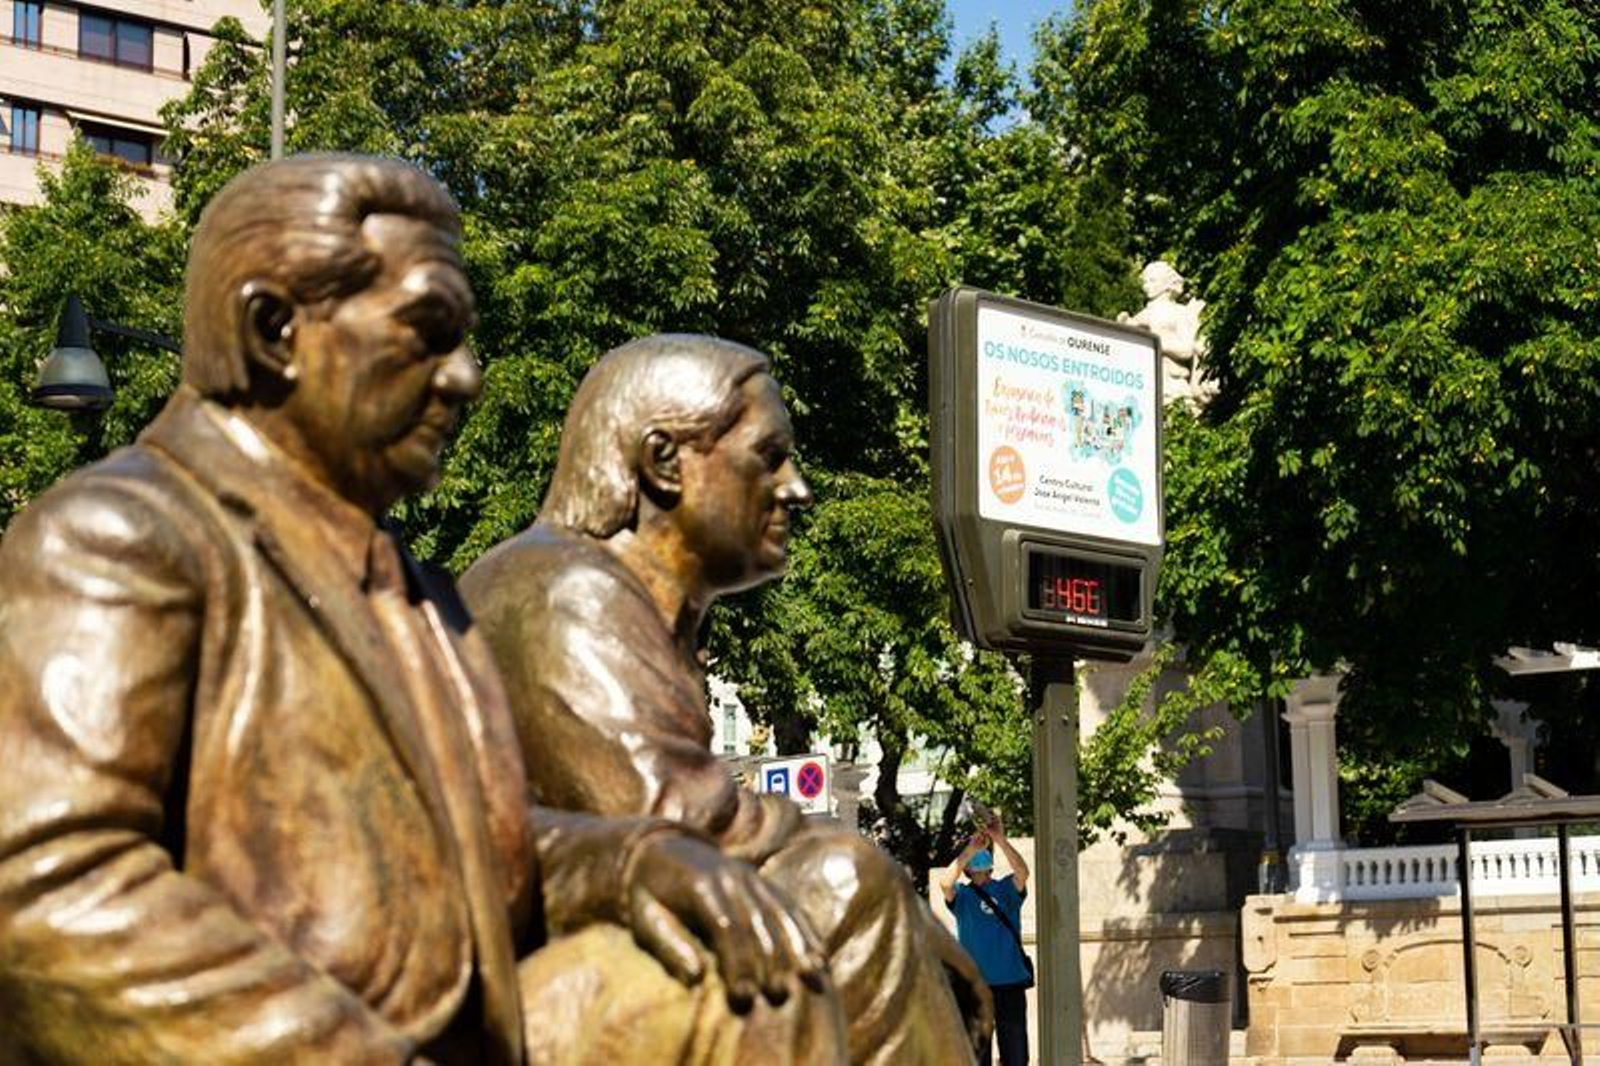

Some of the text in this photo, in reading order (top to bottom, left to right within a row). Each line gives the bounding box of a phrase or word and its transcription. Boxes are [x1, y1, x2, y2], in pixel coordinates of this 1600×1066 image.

[1067, 337, 1111, 355] OURENSE
[984, 340, 1005, 360] OS
[1007, 346, 1060, 372] NOSOS
[1062, 358, 1145, 390] ENTROIDOS
[1039, 474, 1064, 488] Centro
